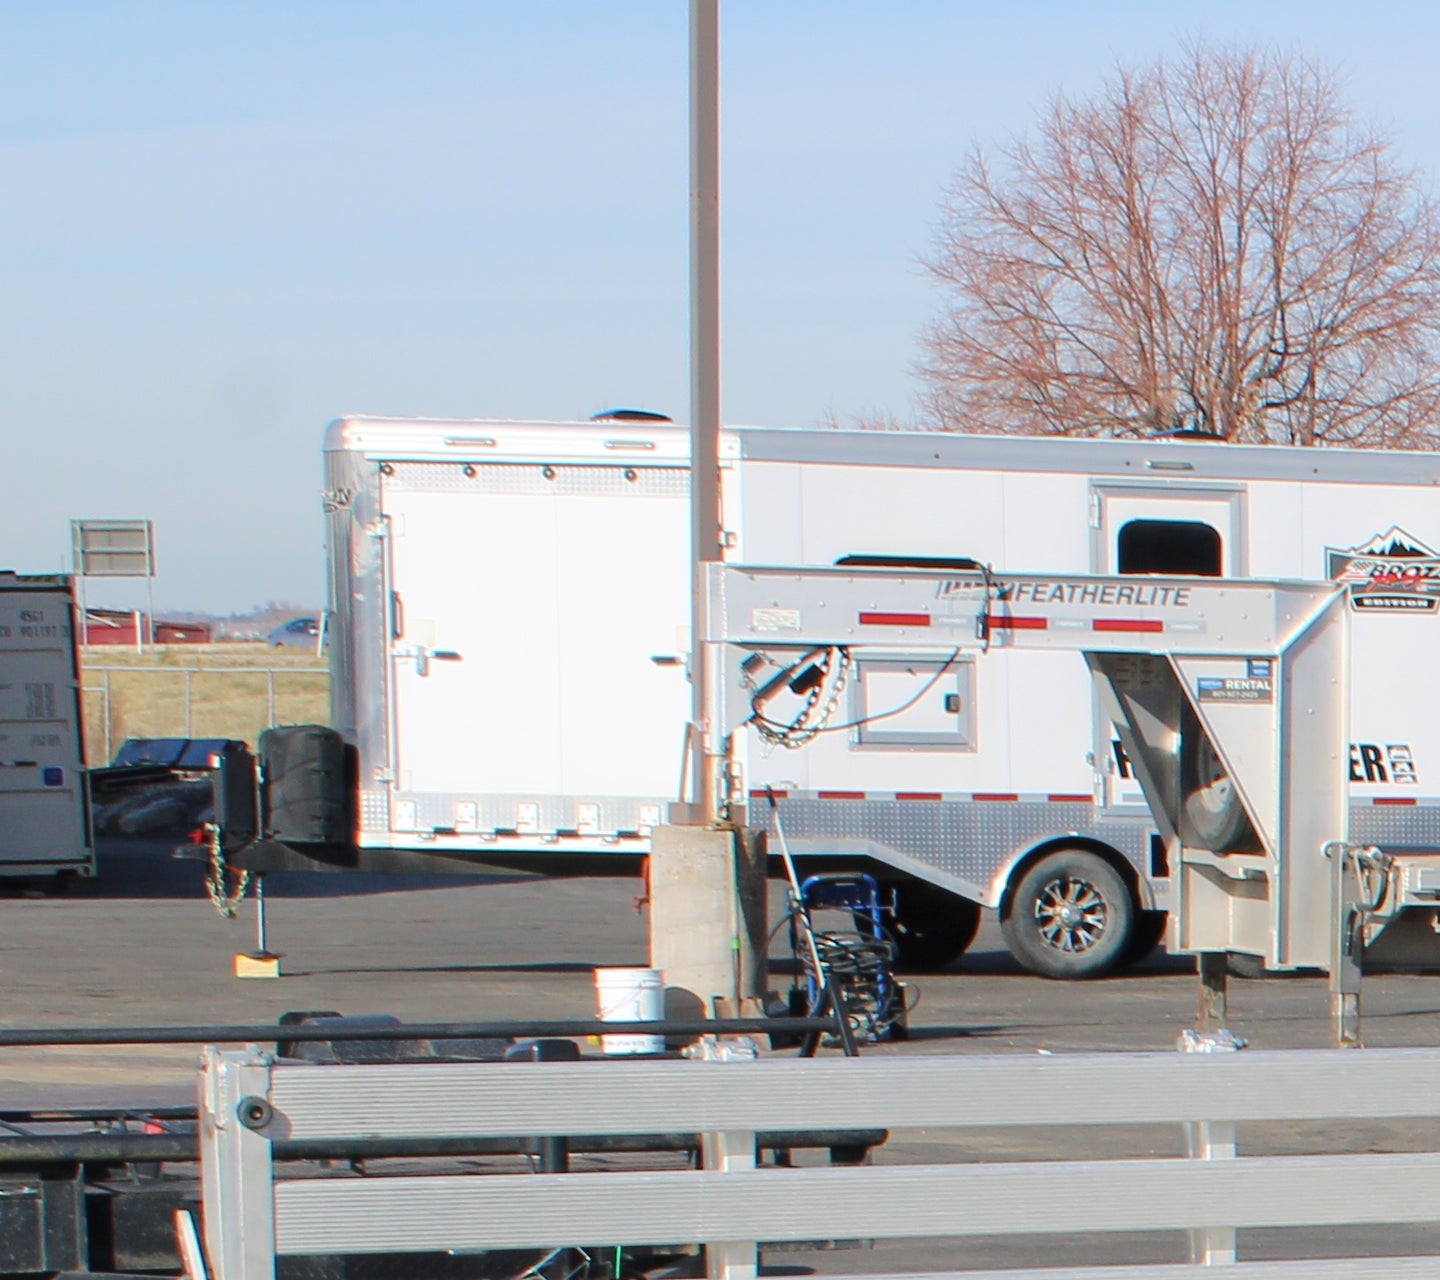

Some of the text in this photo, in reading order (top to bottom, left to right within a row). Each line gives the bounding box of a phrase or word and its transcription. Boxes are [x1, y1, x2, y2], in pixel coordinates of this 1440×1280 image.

[1014, 583, 1192, 607] FEATHERLITE
[1362, 597, 1429, 608] EDITION
[1225, 680, 1272, 691] RENTAL
